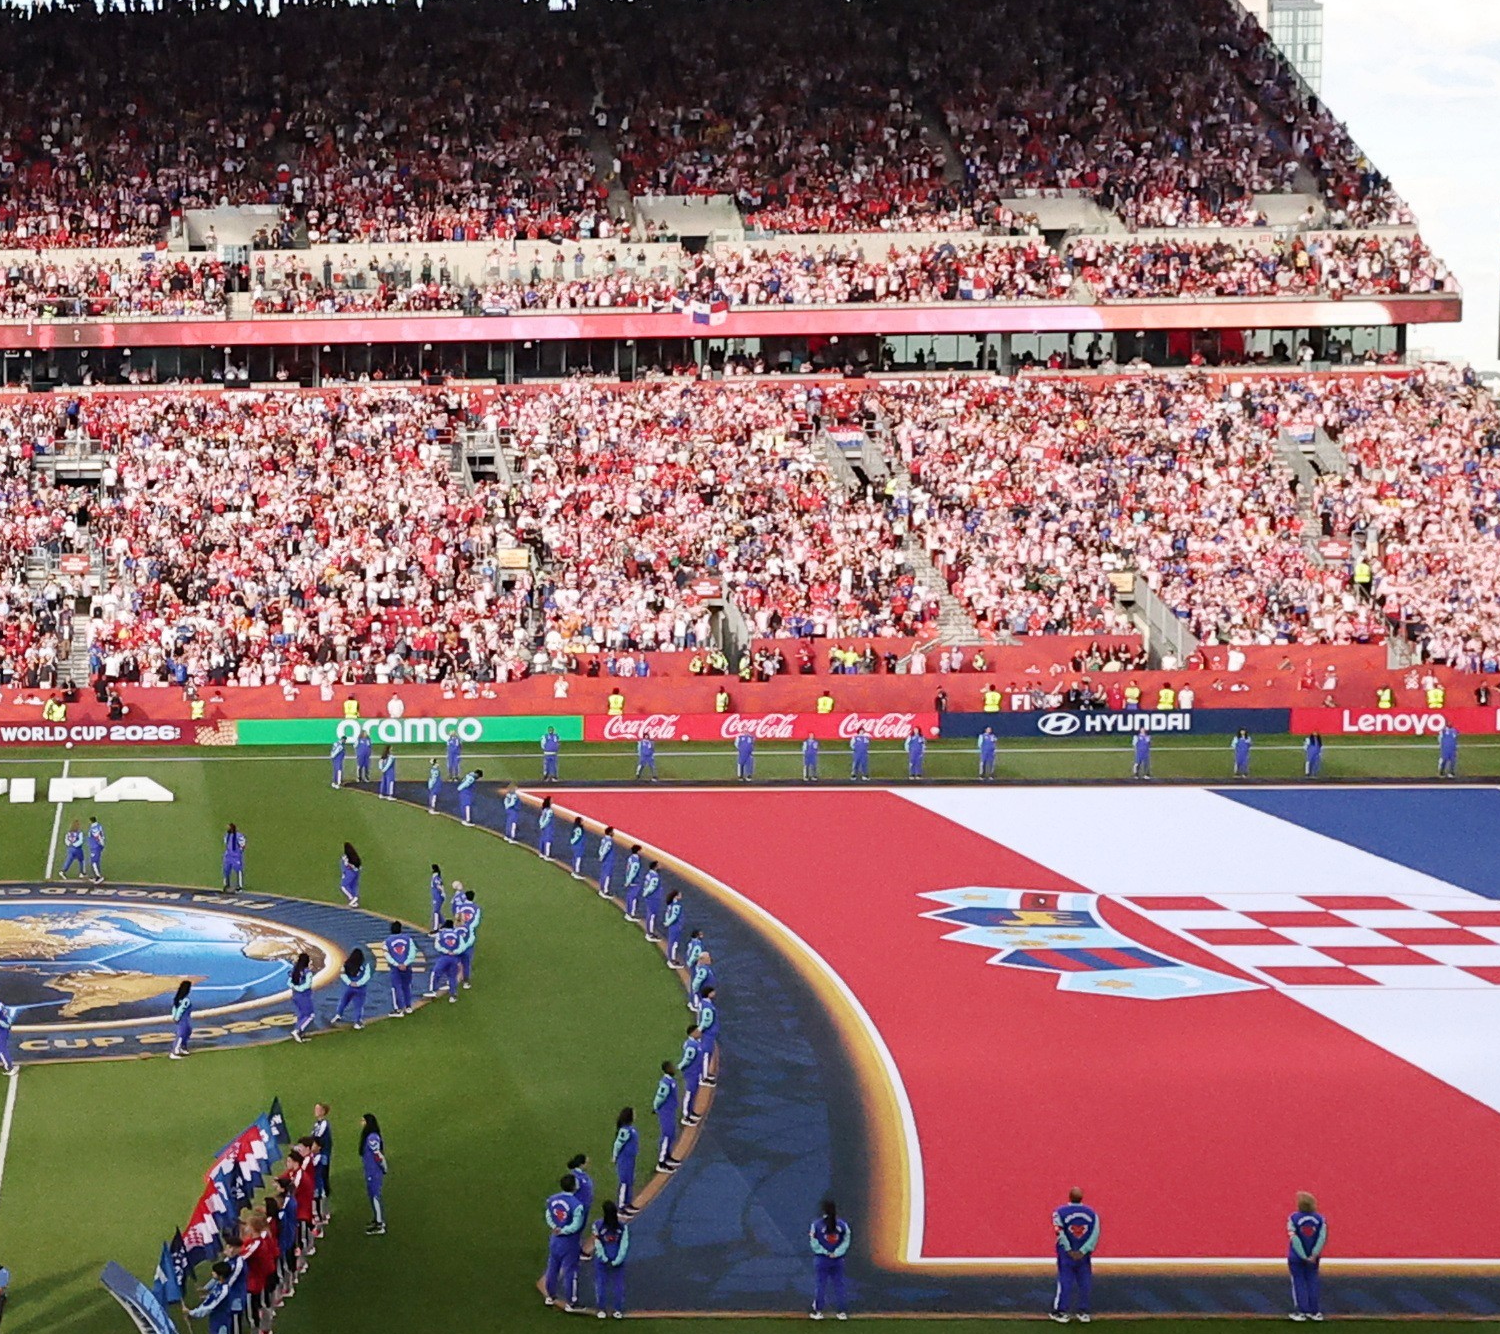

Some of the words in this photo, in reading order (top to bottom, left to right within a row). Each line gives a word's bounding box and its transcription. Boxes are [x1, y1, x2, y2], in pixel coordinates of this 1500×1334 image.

[0, 726, 66, 744] WORLD
[67, 725, 106, 743] CUP
[109, 724, 174, 742] 2026
[336, 716, 484, 744] aramco
[1084, 710, 1192, 733] HYUNDAI
[1342, 707, 1447, 734] Lenovo
[18, 1035, 126, 1051] CUP
[134, 1013, 298, 1045] 2026
